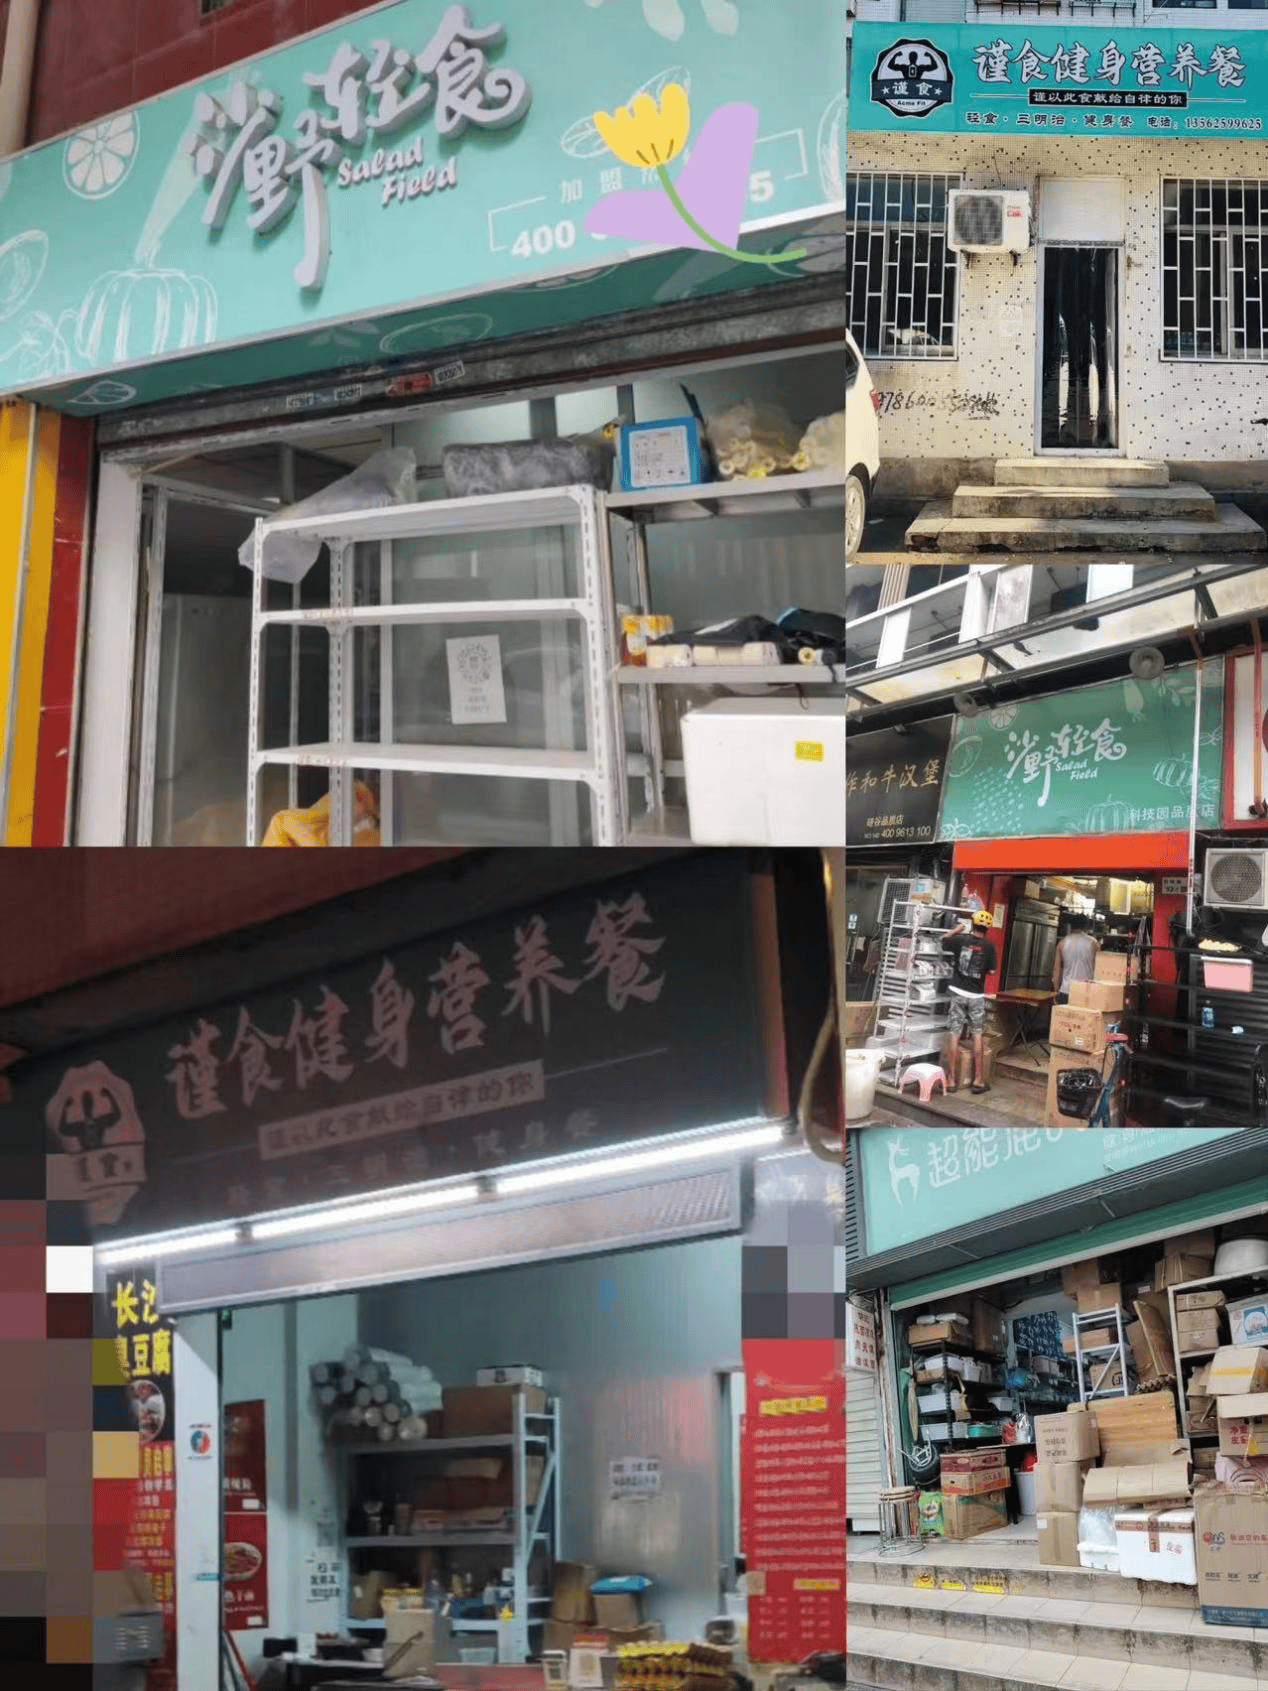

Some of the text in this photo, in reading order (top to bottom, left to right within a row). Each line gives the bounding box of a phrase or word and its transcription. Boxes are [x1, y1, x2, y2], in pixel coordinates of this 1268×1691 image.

[970, 38, 1249, 88] 谨食健身营养餐
[337, 136, 424, 190] Salad
[381, 157, 460, 208] Field
